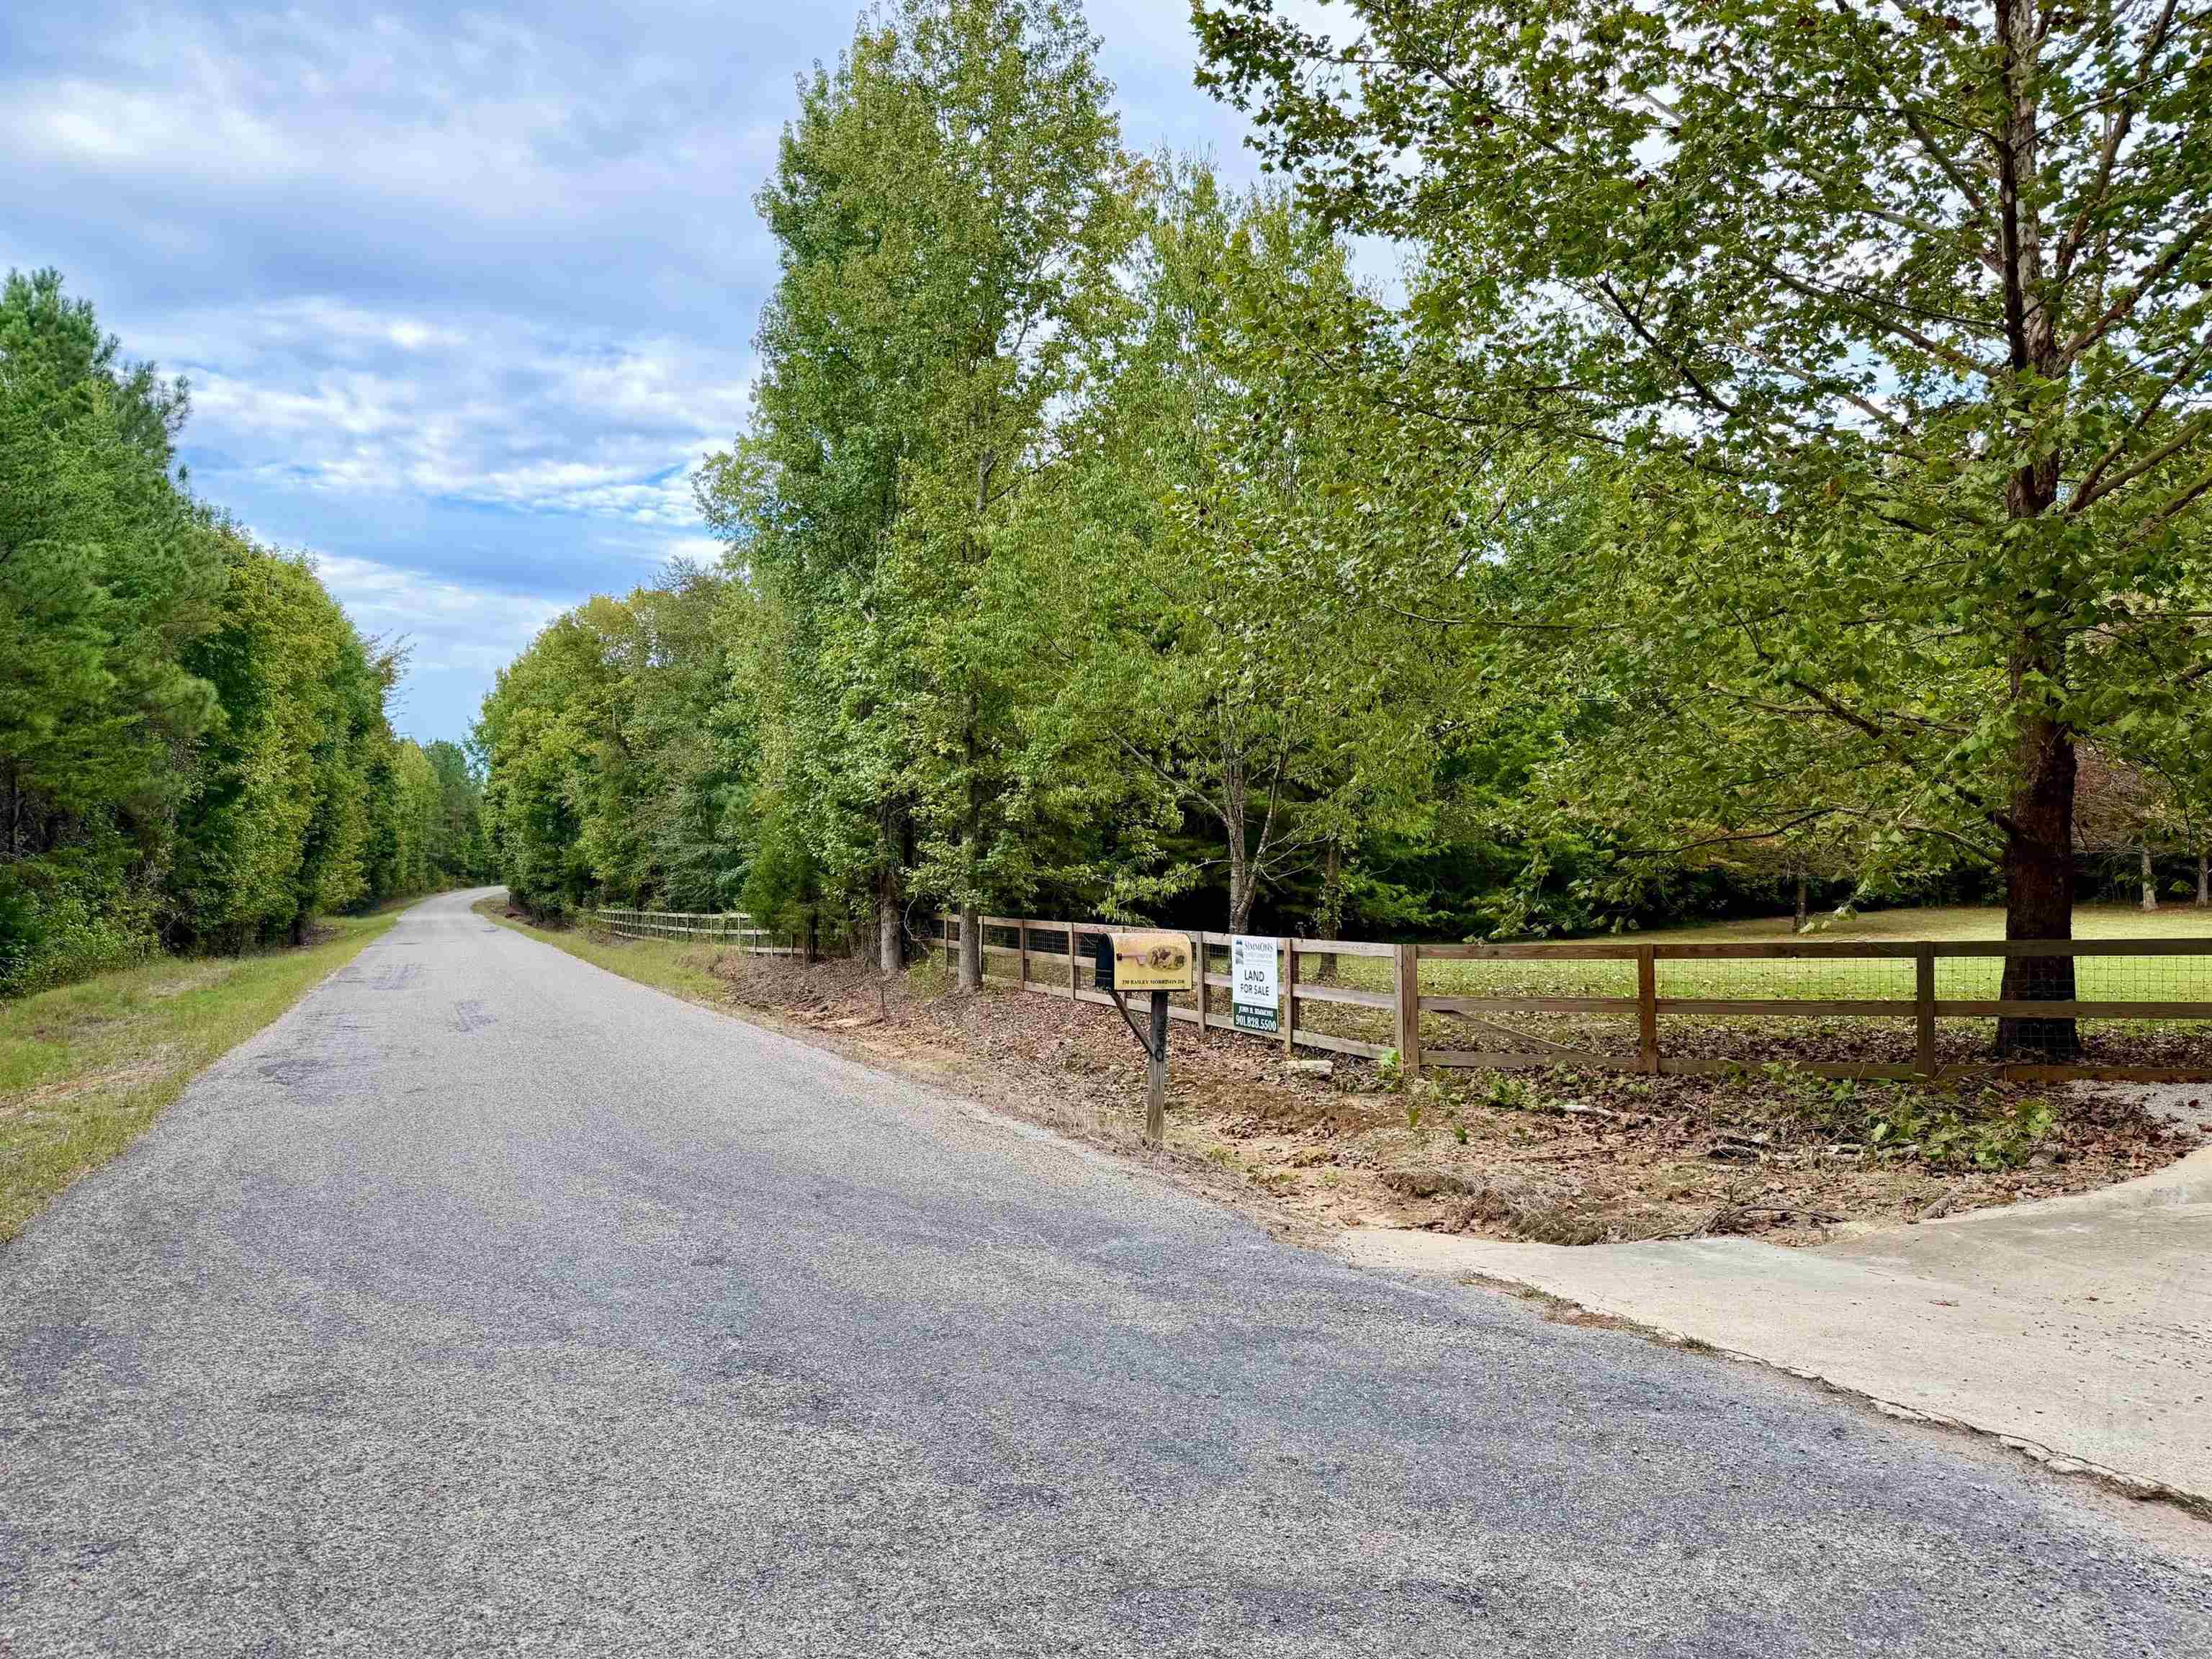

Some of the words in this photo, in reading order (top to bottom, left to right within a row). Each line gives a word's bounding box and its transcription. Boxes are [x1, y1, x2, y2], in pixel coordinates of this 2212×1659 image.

[1244, 942, 1274, 951] SIMMONS
[1244, 970, 1264, 982] LAND
[1240, 984, 1252, 994] FOR
[1254, 985, 1269, 996] SALE
[1236, 1015, 1277, 1031] 901.828.5500
